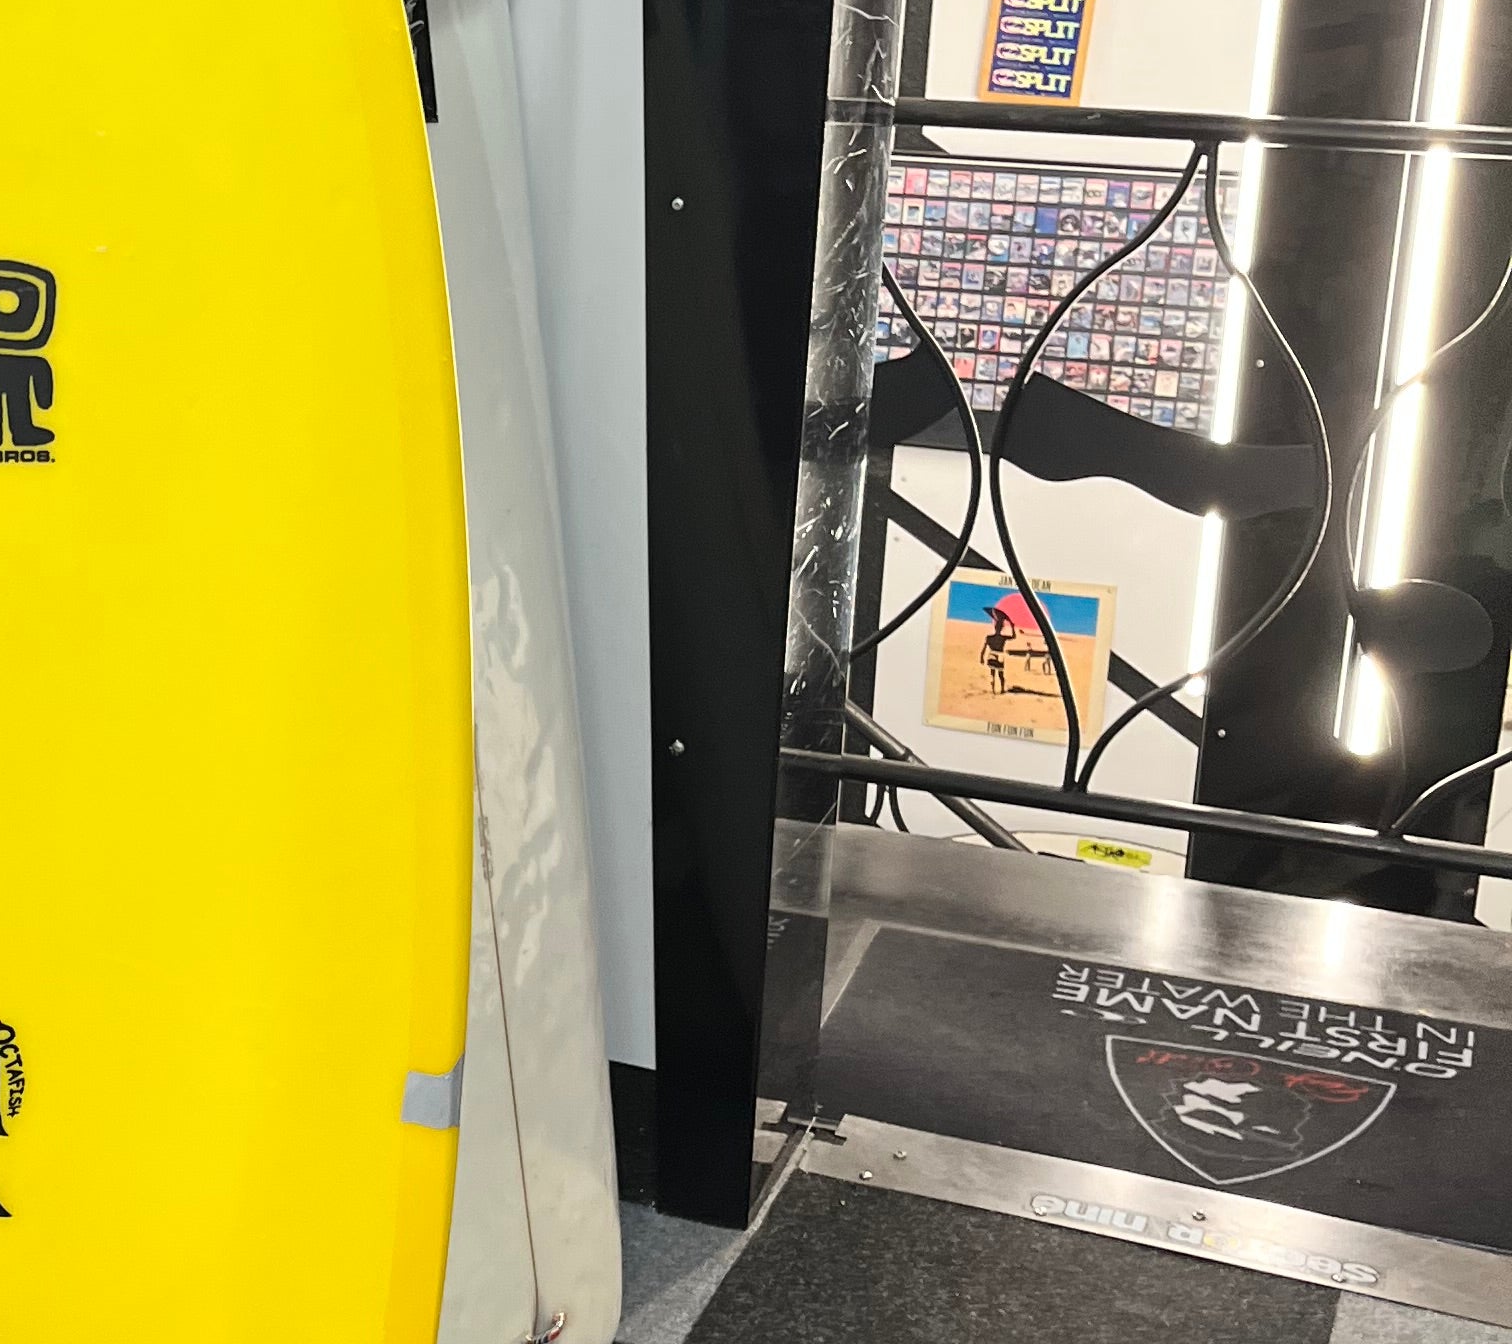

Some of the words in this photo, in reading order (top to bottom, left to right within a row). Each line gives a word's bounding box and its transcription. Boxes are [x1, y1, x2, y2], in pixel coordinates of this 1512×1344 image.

[1025, 17, 1080, 40] SPLIT
[1021, 43, 1076, 66] SPLIT
[1016, 70, 1072, 93] SPLIT
[987, 721, 1001, 734] FUN
[1003, 723, 1018, 736] FUN
[1019, 726, 1034, 738] FUN
[1056, 962, 1261, 1013] WATER
[1051, 980, 1261, 1032] NAME
[1278, 1000, 1399, 1034] THE
[1278, 1020, 1474, 1068] FIRST
[1416, 1020, 1476, 1048] IN
[1190, 1024, 1460, 1079] O'NEILL
